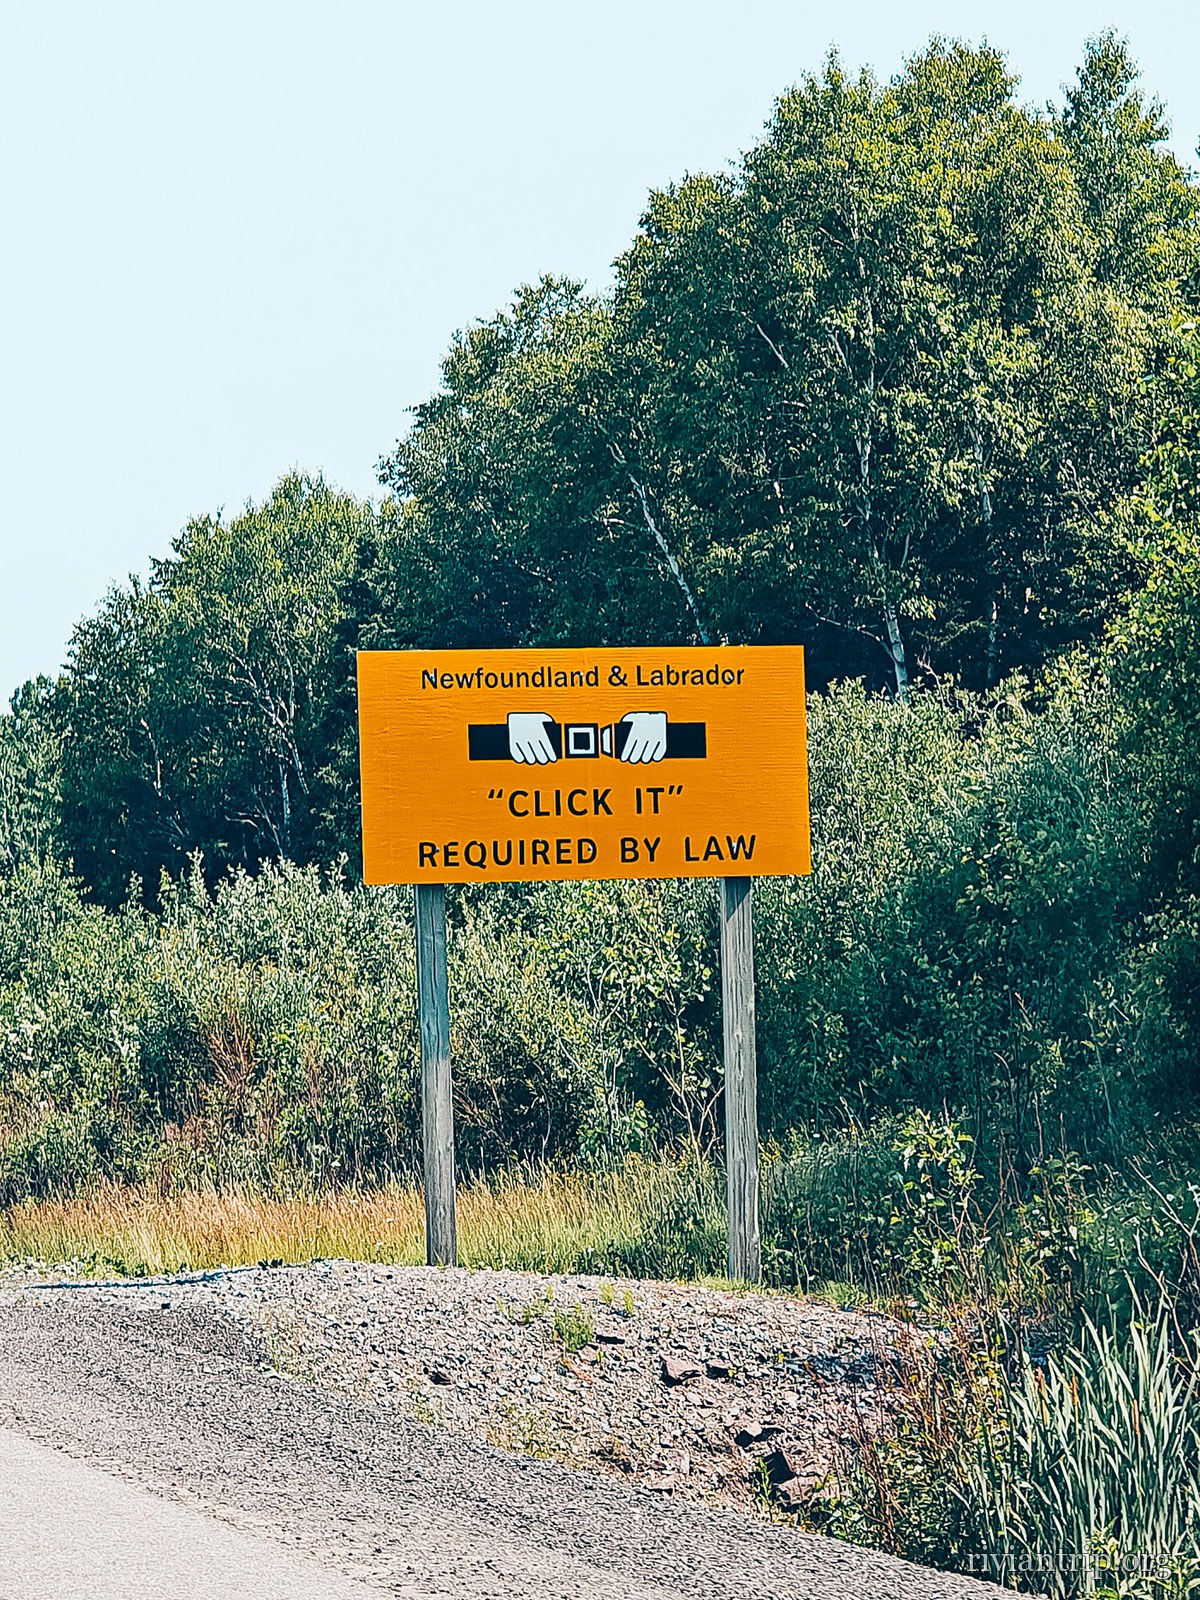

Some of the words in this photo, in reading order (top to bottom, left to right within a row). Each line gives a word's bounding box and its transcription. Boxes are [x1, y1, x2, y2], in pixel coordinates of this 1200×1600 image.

[422, 666, 598, 689] Newfoundland
[609, 666, 627, 686] &
[637, 664, 744, 686] Labrador
[419, 838, 597, 869] REQUIRED
[621, 837, 660, 862] BY
[685, 835, 755, 861] LAW
